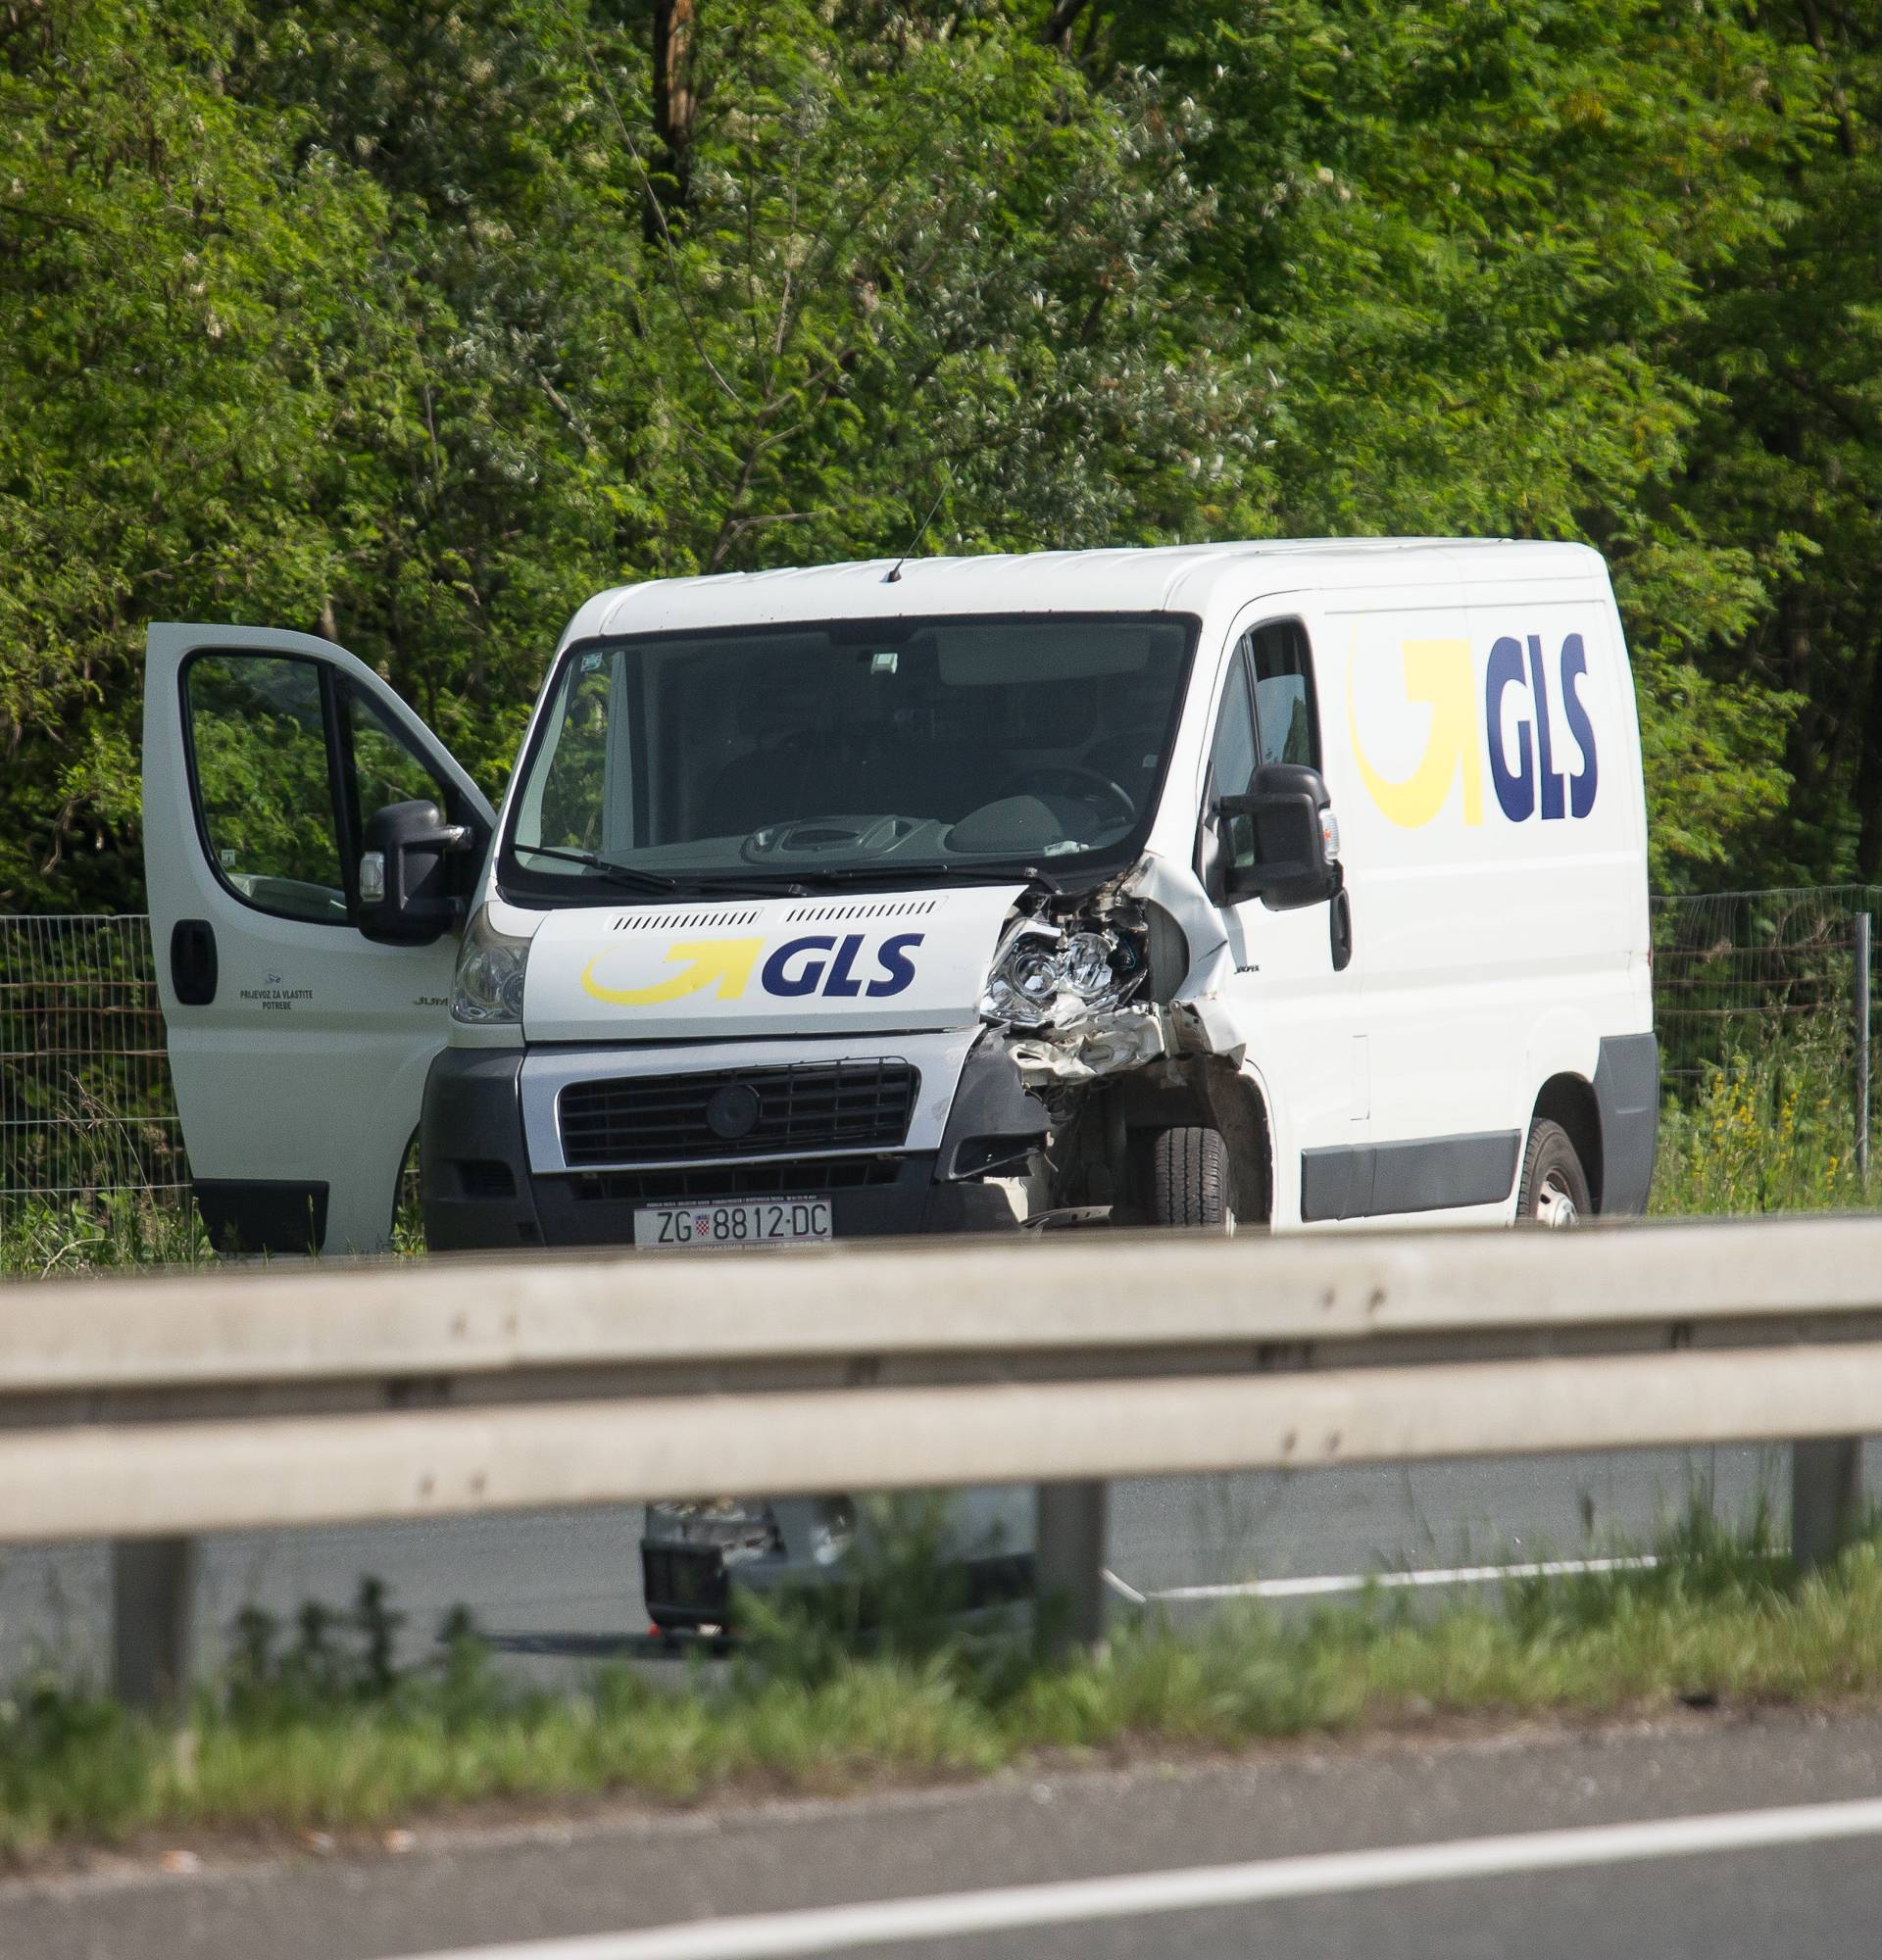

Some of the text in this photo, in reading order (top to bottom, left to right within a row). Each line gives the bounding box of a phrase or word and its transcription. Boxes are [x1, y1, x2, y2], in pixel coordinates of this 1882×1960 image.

[1486, 633, 1598, 822] GLS
[762, 933, 925, 997] GLS
[240, 990, 313, 1000] PRIJEVOZ ZA VLASTITE
[262, 1001, 292, 1010] POTREBE
[657, 1211, 692, 1243] ZG
